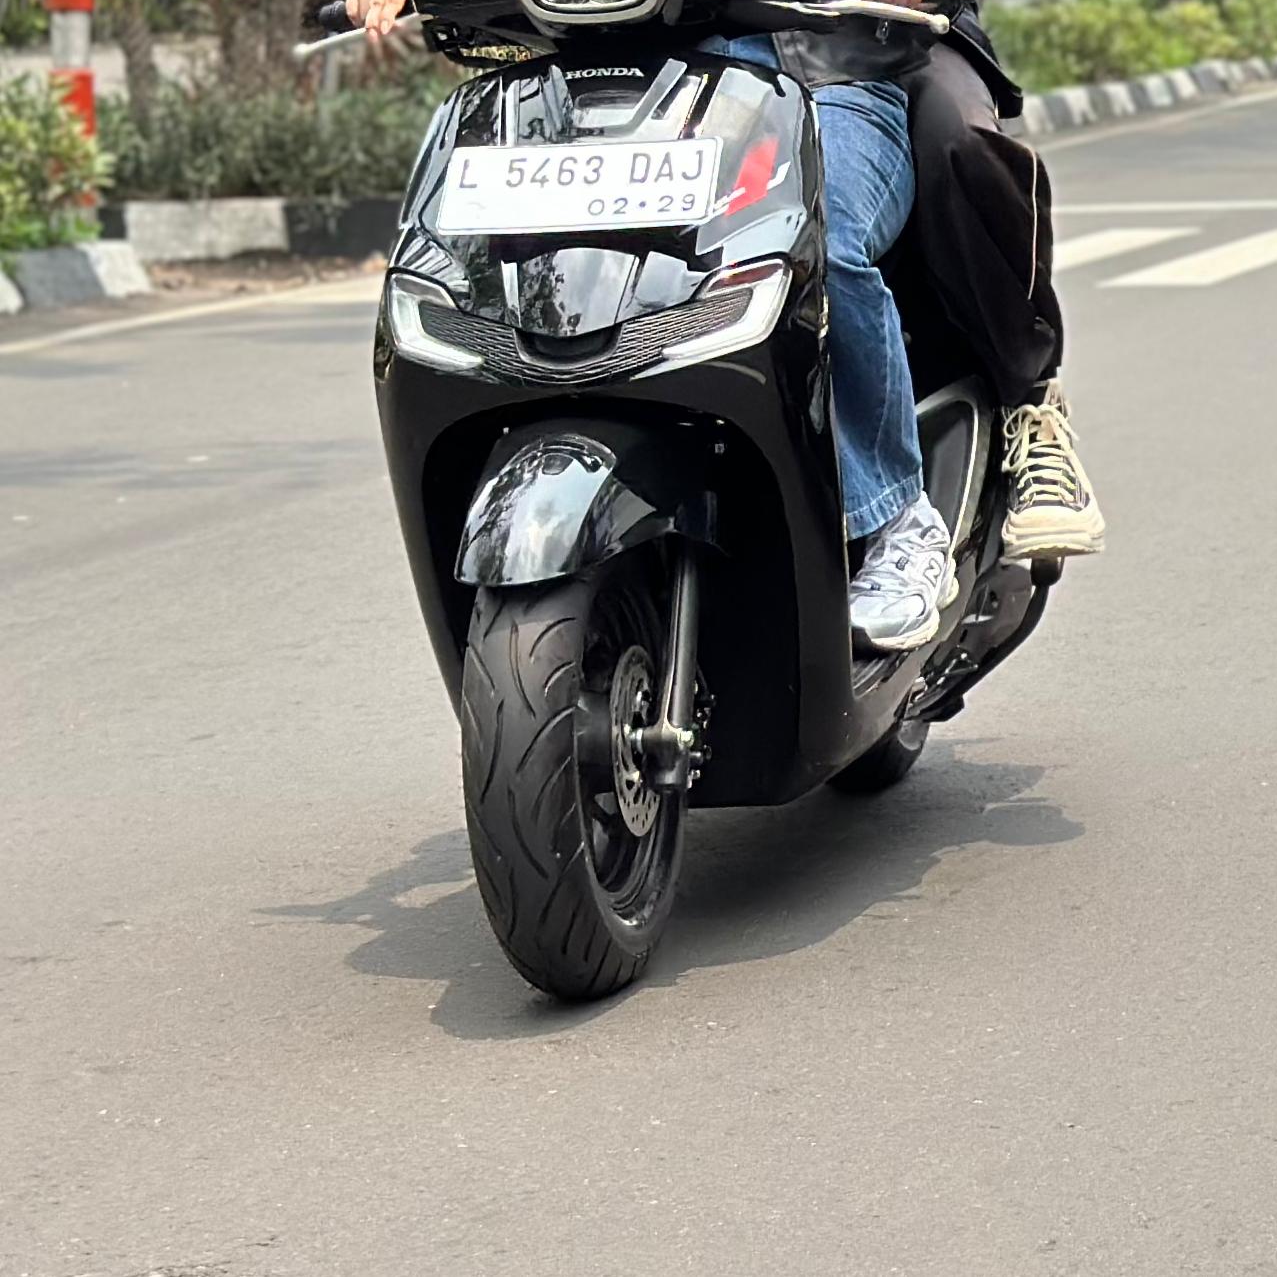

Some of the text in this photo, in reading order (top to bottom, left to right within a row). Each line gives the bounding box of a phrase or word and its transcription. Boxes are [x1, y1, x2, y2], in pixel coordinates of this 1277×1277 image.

[565, 67, 645, 80] HONDA
[458, 149, 704, 189] L 5463 DAJ
